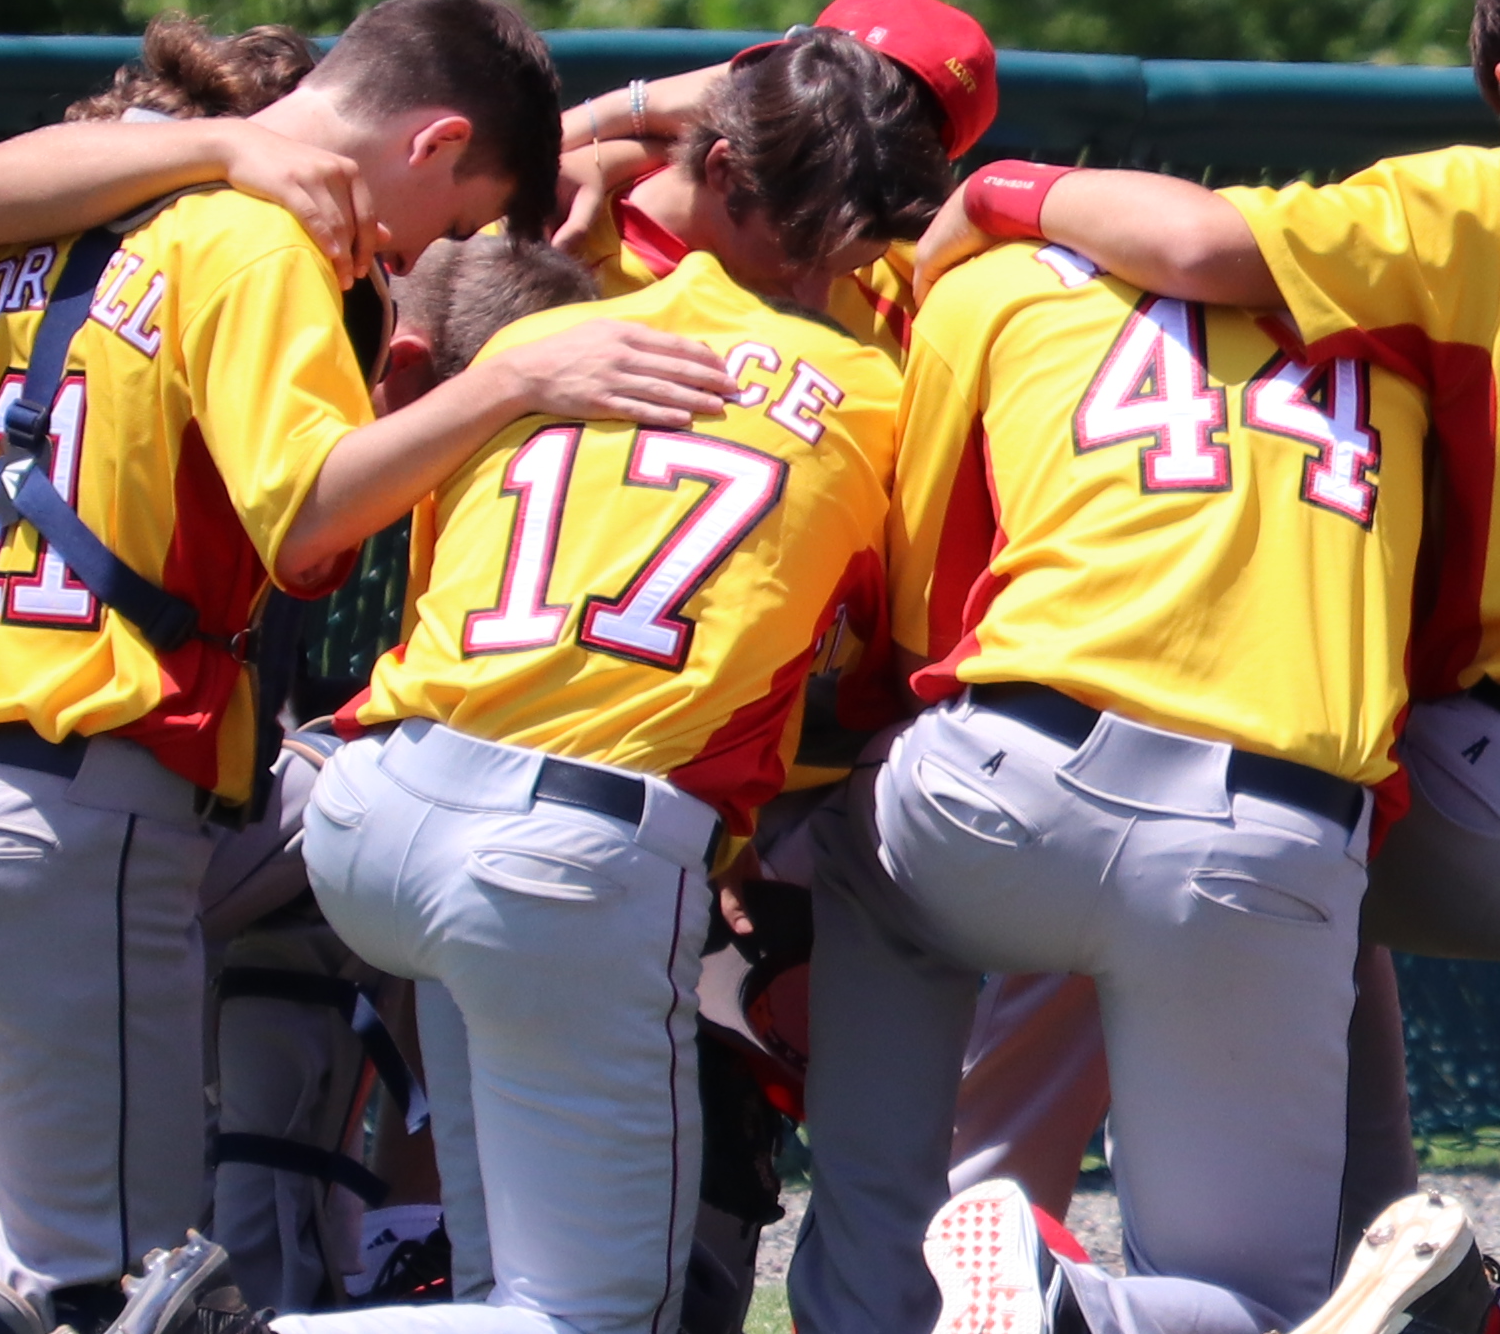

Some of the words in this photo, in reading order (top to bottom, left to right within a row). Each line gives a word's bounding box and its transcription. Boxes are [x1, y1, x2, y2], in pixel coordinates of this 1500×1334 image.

[722, 340, 846, 446] CE
[1071, 290, 1381, 534] 44
[460, 421, 790, 674] 17
